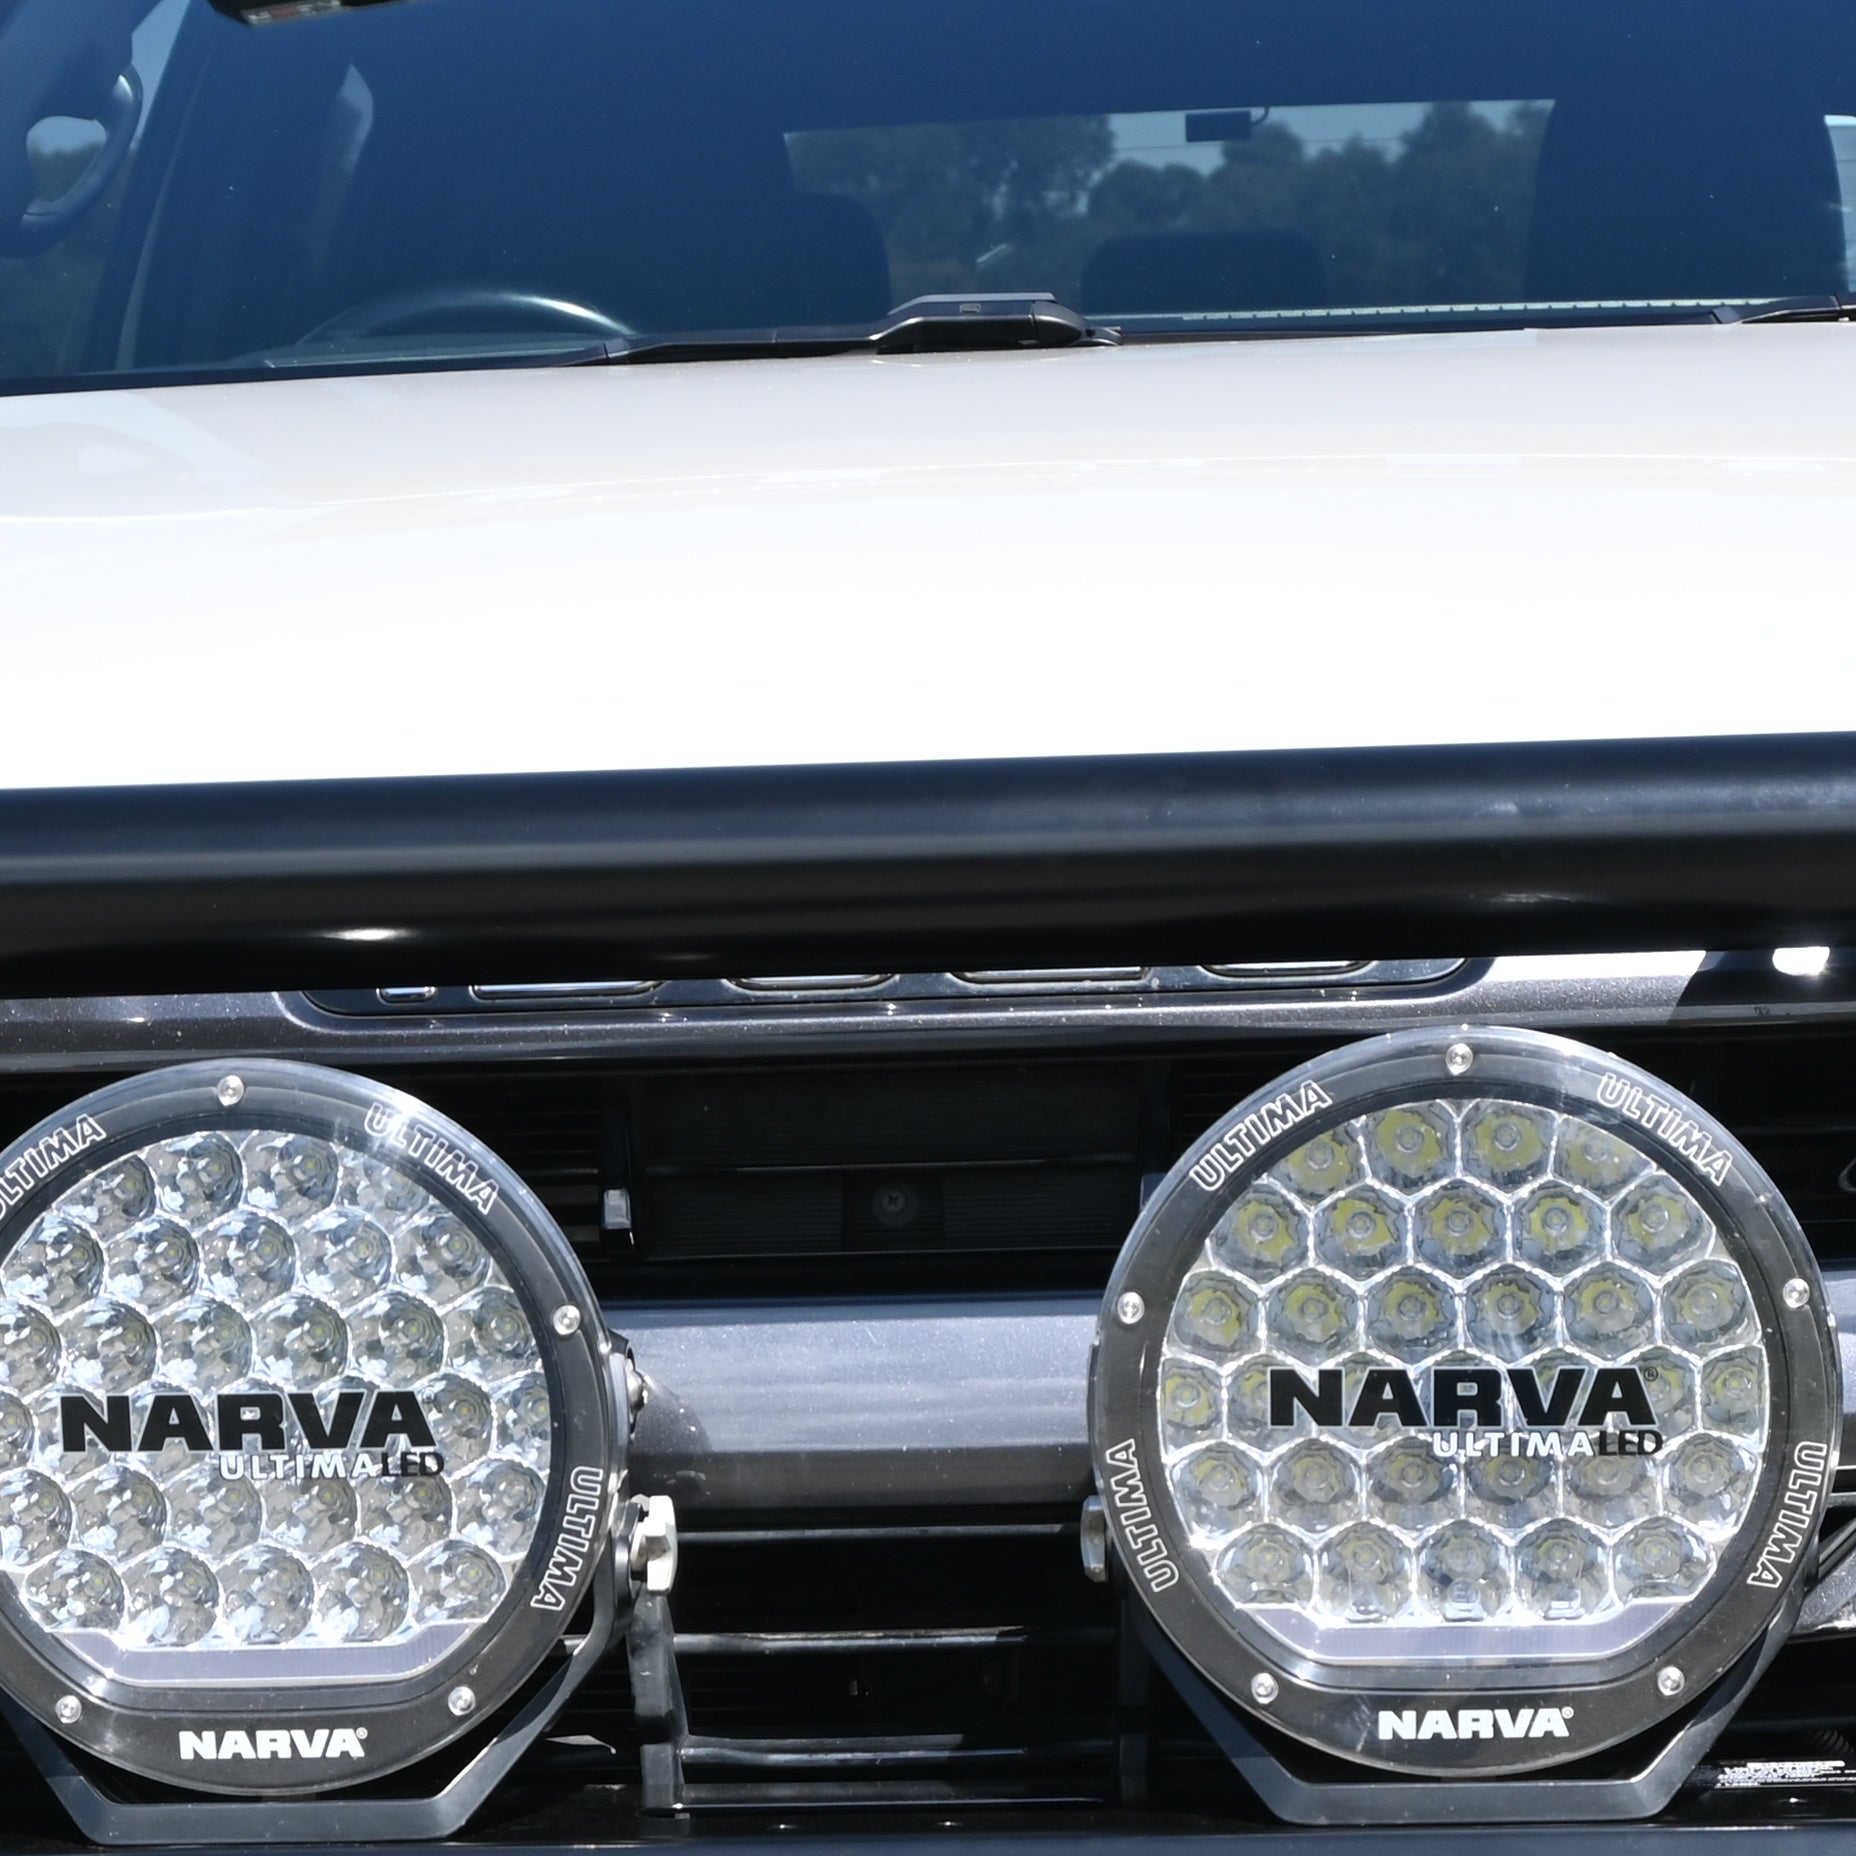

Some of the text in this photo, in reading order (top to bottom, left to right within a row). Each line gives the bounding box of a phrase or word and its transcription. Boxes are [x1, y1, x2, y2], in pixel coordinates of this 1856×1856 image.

[363, 1102, 500, 1215] ULTIMA
[1189, 1081, 1333, 1191] ULTIMA
[1595, 1072, 1732, 1184] ULTIMA
[531, 1465, 603, 1613] ULTIMA
[1102, 1439, 1178, 1593] ULTIMA
[1747, 1440, 1828, 1591] ULTIMA
